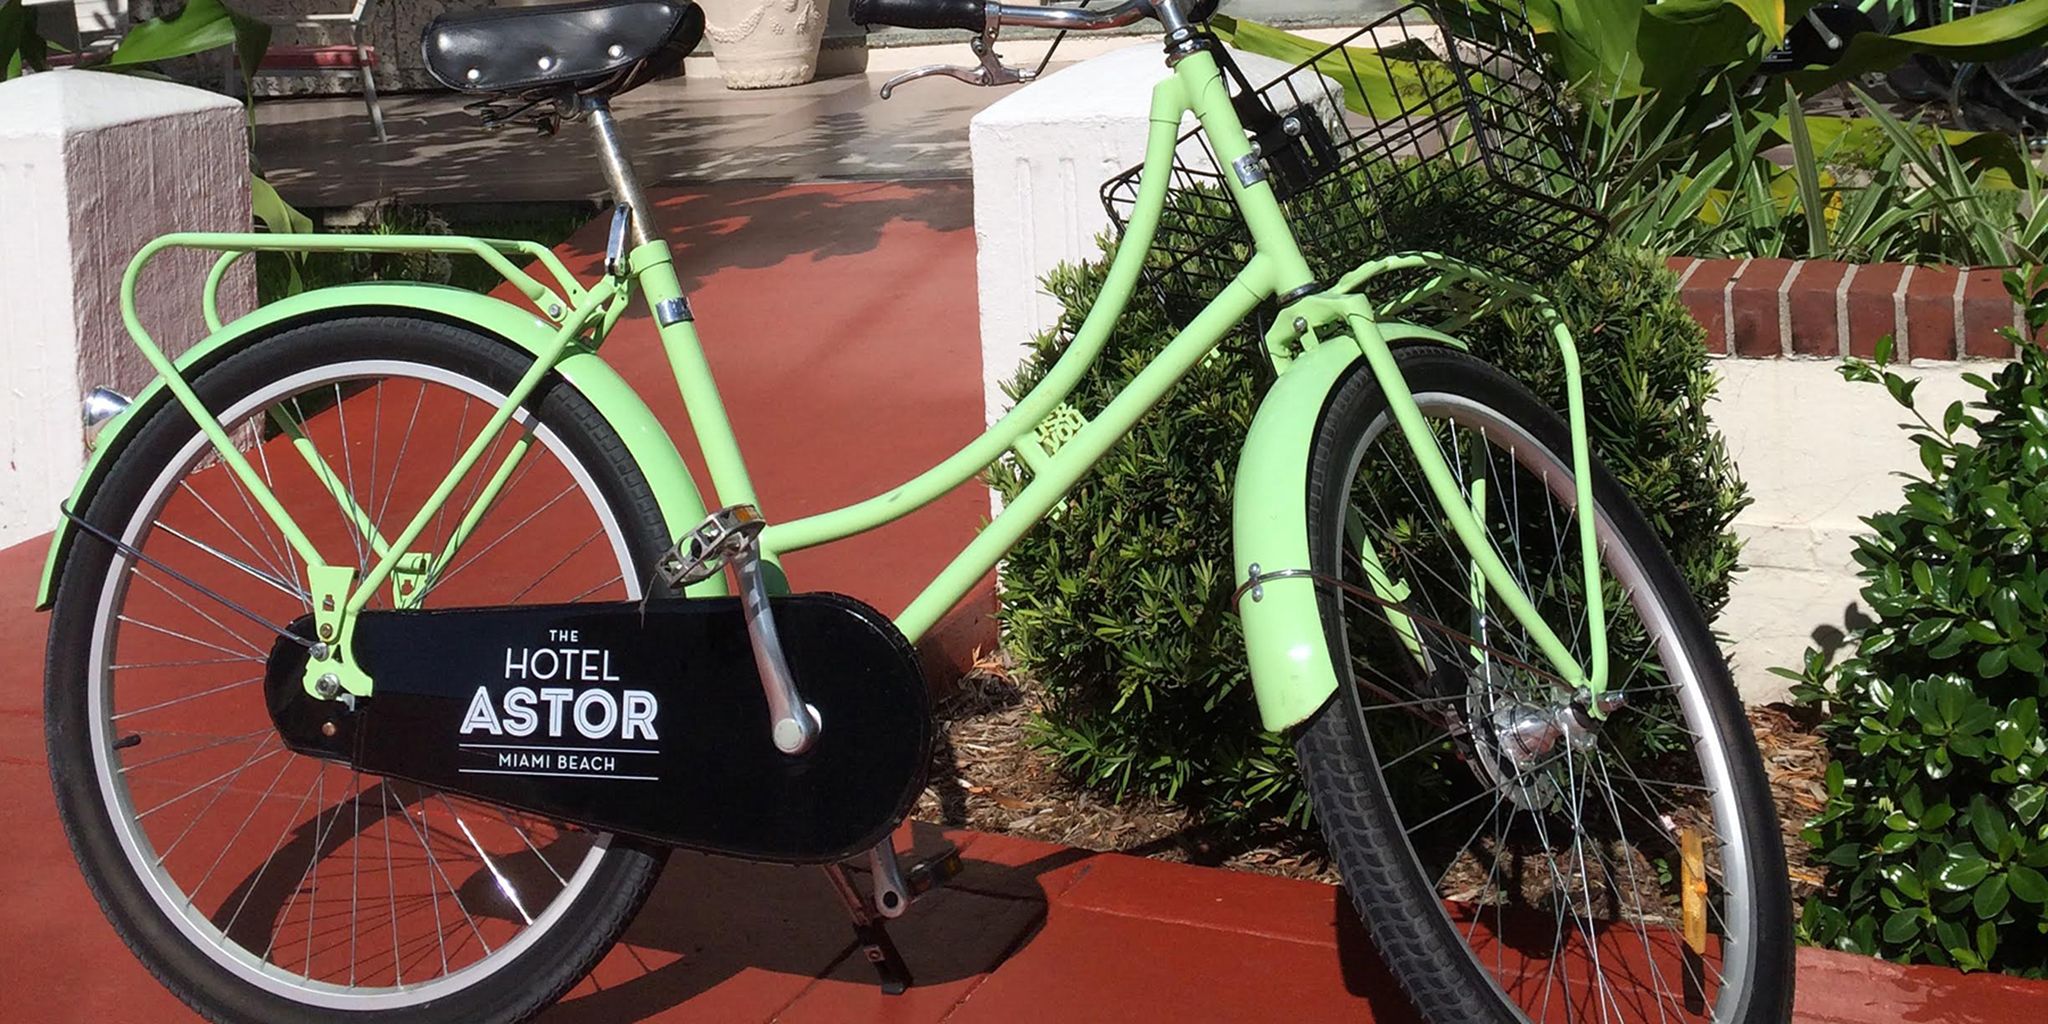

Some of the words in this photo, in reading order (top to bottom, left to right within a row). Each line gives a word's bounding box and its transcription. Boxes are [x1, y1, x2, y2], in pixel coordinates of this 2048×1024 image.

[549, 629, 579, 642] THE
[504, 647, 620, 681] HOTEL
[459, 686, 659, 740] ASTOR
[498, 752, 550, 769] MIAMI
[557, 755, 615, 771] BEACH
